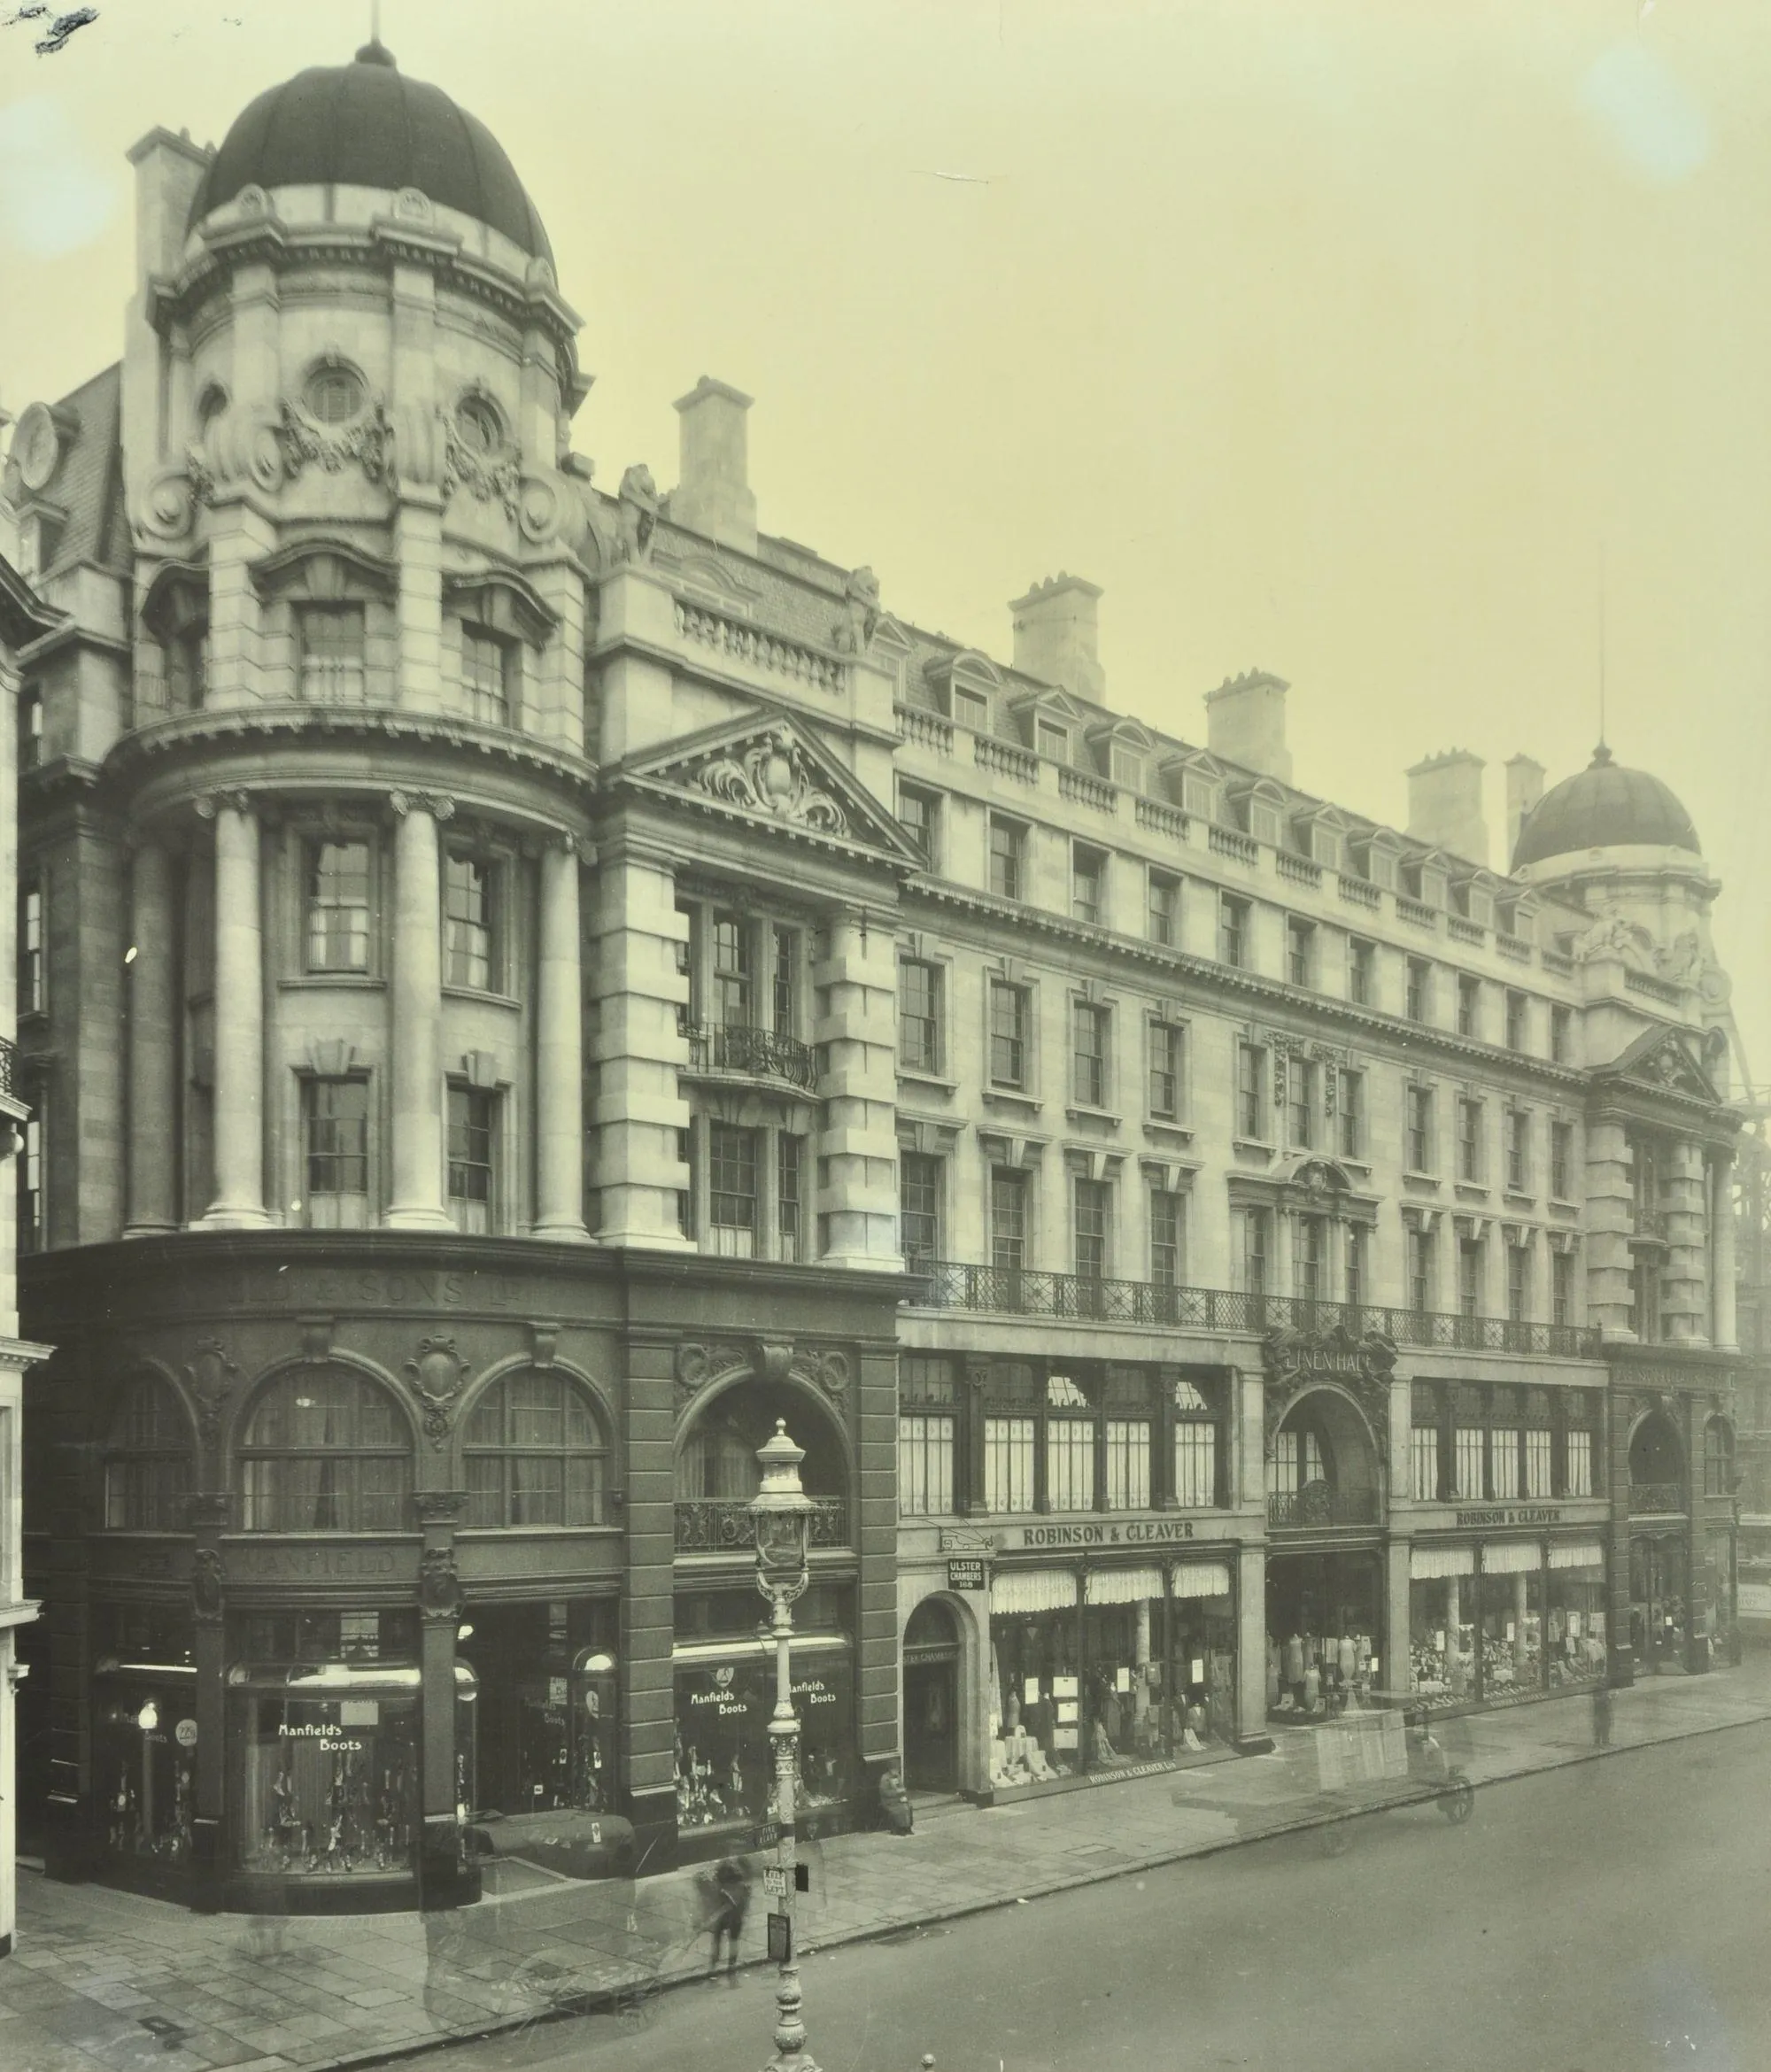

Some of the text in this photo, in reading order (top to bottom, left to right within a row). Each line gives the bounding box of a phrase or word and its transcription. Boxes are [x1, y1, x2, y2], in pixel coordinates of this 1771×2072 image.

[355, 1275, 464, 1304] SONS
[1286, 1349, 1332, 1371] LINEN
[1456, 1507, 1561, 1526] ROBINSON & CLEAVER
[1023, 1521, 1195, 1546] ROBINSON & CLEAVER
[949, 1561, 981, 1571] ULSTER
[950, 1572, 982, 1581] CHAMBERS
[691, 1691, 735, 1705] Manfield's
[809, 1692, 837, 1705] Boots
[718, 1703, 748, 1715] Boots
[278, 1723, 343, 1736] Manfield's
[320, 1738, 362, 1751] Boots
[1089, 1769, 1126, 1785] ROBINSON
[1133, 1762, 1164, 1776] CLEAVER
